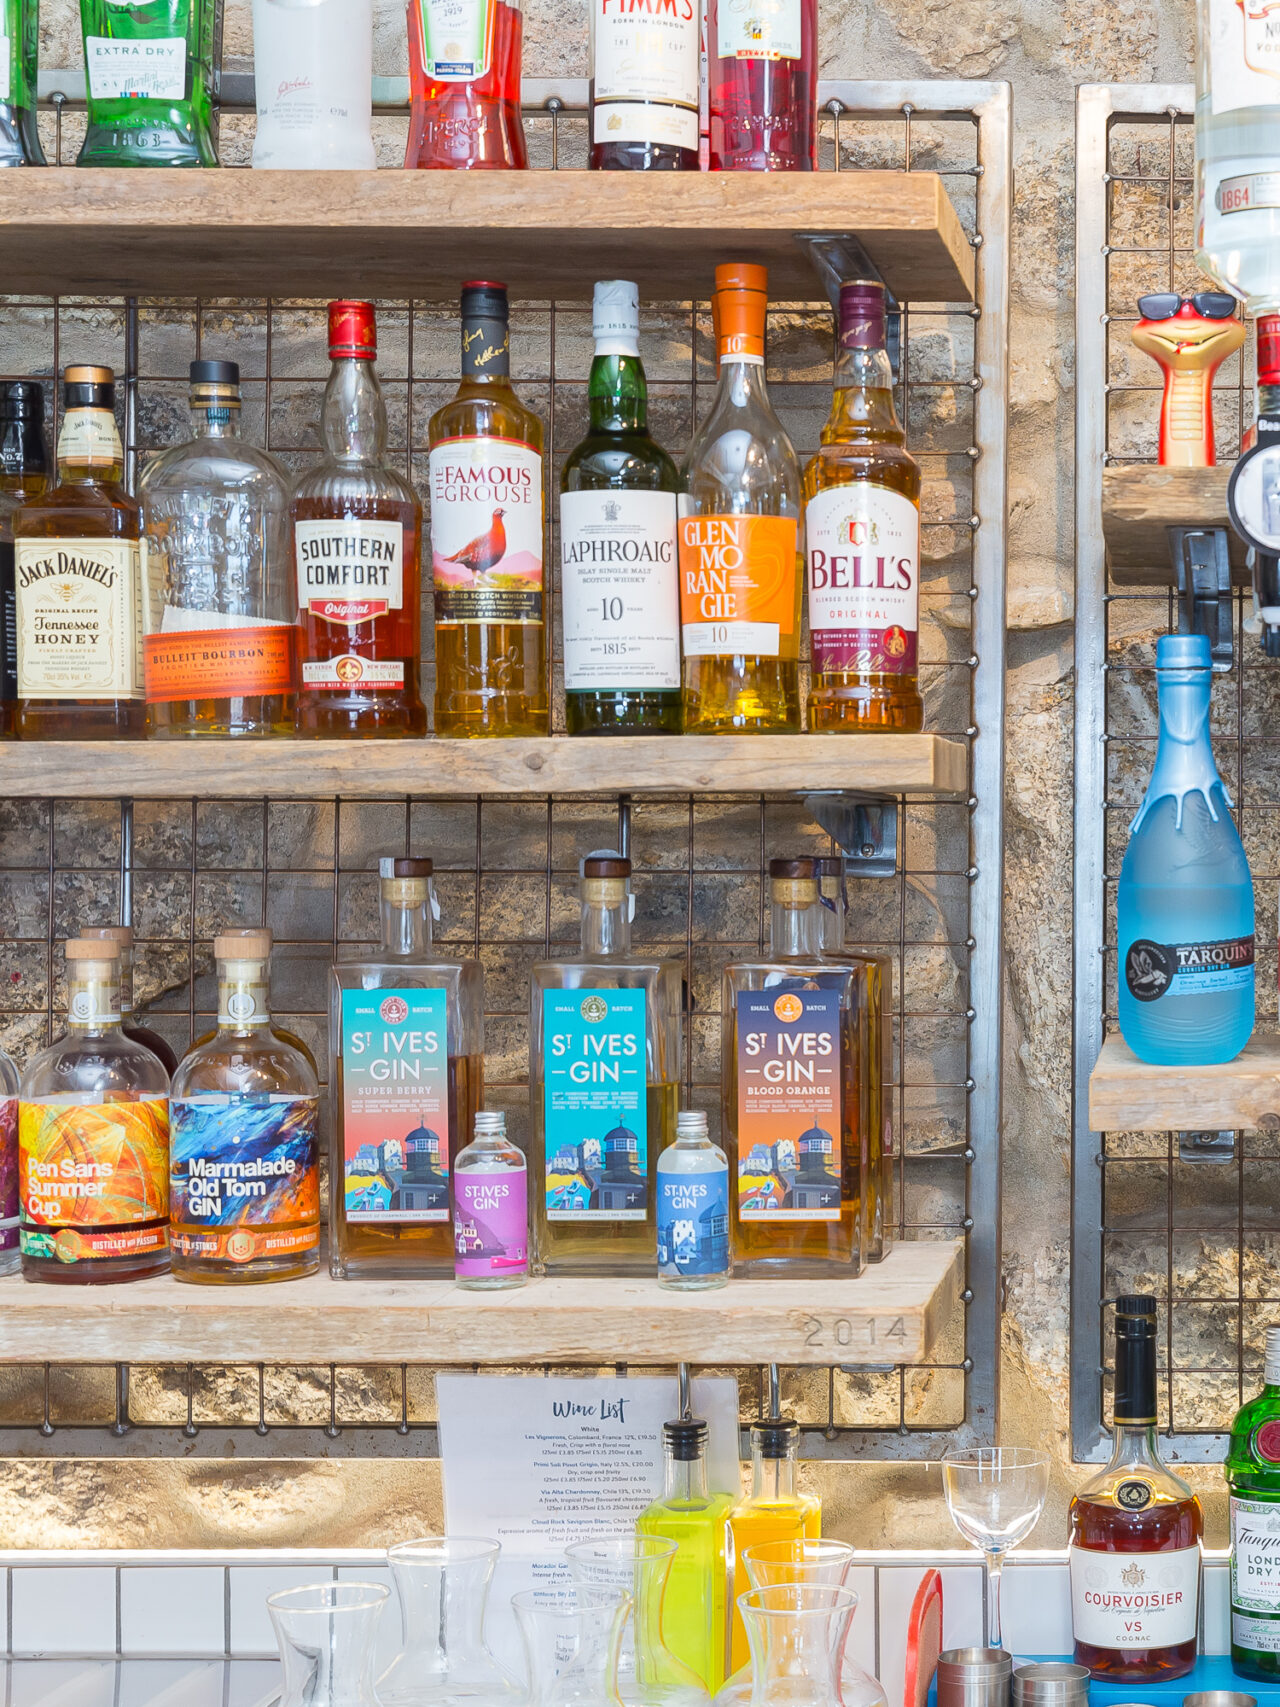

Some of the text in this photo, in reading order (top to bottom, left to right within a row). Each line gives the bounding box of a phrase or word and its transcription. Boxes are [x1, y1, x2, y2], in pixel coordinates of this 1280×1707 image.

[652, 20, 684, 29] LONDON
[96, 47, 175, 56] EXTRA DRY
[1221, 187, 1250, 209] 1864
[725, 336, 742, 353] 10
[436, 467, 444, 501] THE
[445, 466, 531, 486] FAMOUS
[444, 485, 531, 504] GROUSE
[684, 521, 740, 546] GLEN
[301, 537, 396, 562] SOUTHERN
[563, 540, 672, 564] LAPHROAIG
[700, 545, 743, 570] MO
[18, 552, 118, 588] JACK DANIEL'S
[306, 565, 391, 586] COMFORT
[811, 549, 912, 591] BELL'S
[686, 570, 727, 595] RAN
[325, 603, 369, 617] Original
[601, 597, 623, 621] 10
[700, 593, 737, 618] GIE
[830, 610, 888, 619] ORIGINAL
[34, 616, 99, 630] Tennessee
[34, 634, 100, 644] HONEY
[711, 625, 728, 643] 10
[153, 648, 264, 665] BULLEIT BOURBON
[603, 643, 627, 655] 1815
[351, 1031, 439, 1054] ST IVES
[552, 1033, 637, 1056] ST IVES
[745, 1032, 832, 1056] ST IVES
[369, 1059, 421, 1081] GIN
[569, 1061, 619, 1083] GIN
[764, 1060, 815, 1082] GIN
[358, 1086, 432, 1095] SUPER BERRY
[747, 1086, 831, 1095] BLOOD ORANGE
[28, 1158, 113, 1177] Pen Sans
[189, 1156, 296, 1178] Marmalade
[28, 1178, 107, 1197] Summer
[189, 1177, 266, 1197] Old Tom
[29, 1196, 62, 1218] Cup
[189, 1198, 222, 1217] GIN
[474, 1198, 499, 1210] GIN
[672, 1197, 697, 1209] GIN
[92, 1236, 158, 1250] DISTILLED PASSION
[266, 1238, 295, 1249] DISTILLED
[803, 1317, 908, 1347] 2014
[553, 1398, 630, 1423] Wine List
[1247, 1565, 1273, 1577] DRY
[1085, 1592, 1183, 1608] COURVOISIER
[1125, 1622, 1142, 1632] VS
